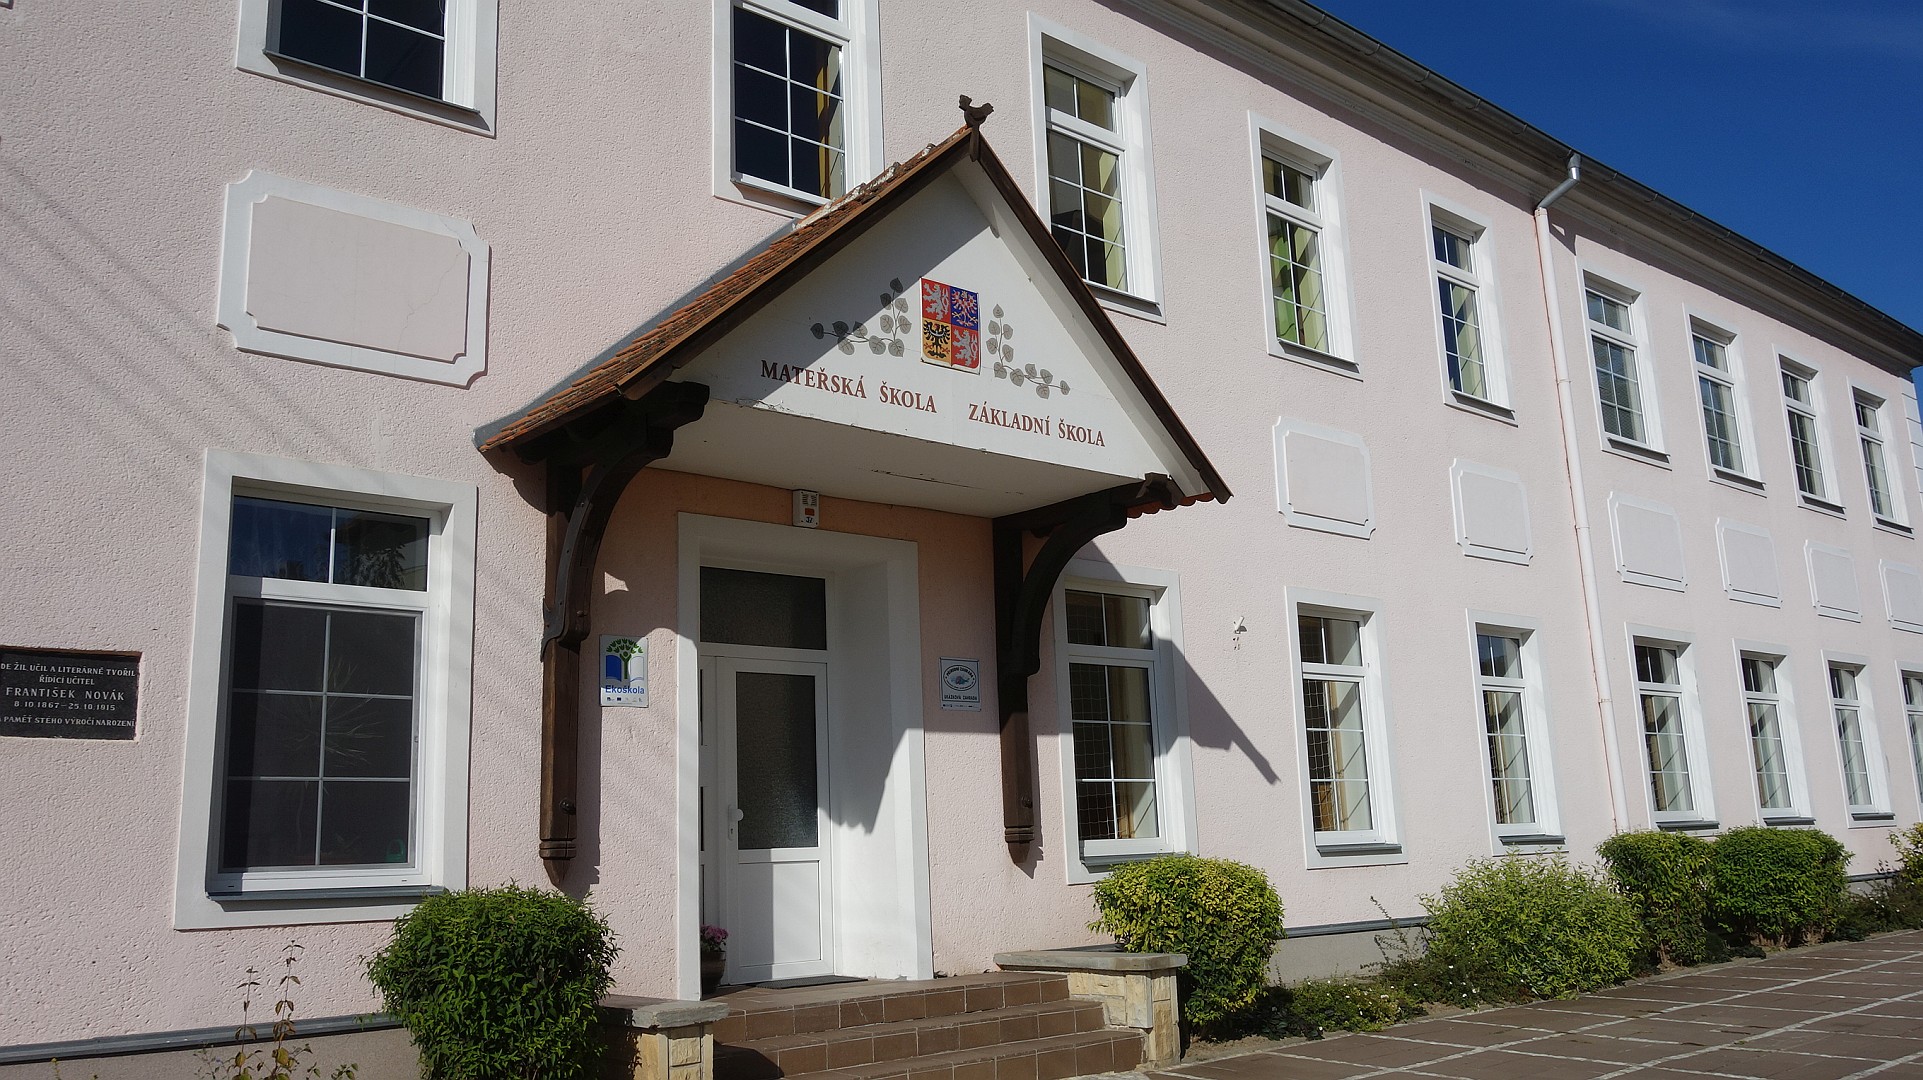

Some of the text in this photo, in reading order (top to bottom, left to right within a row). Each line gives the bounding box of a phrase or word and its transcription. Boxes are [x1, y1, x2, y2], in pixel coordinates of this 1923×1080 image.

[760, 359, 938, 413] MATEŘSKÁ ŠKOLA
[968, 401, 1106, 447] ZÁKLADNÍ ŠKOLA
[29, 663, 48, 672] UČIL
[106, 667, 136, 677] TVOŘIL
[66, 675, 95, 685] UČITEL
[6, 687, 125, 701] FRANTIŠEK NOVÁK
[605, 684, 645, 695] Ekoškola
[34, 715, 63, 725] STÉHO
